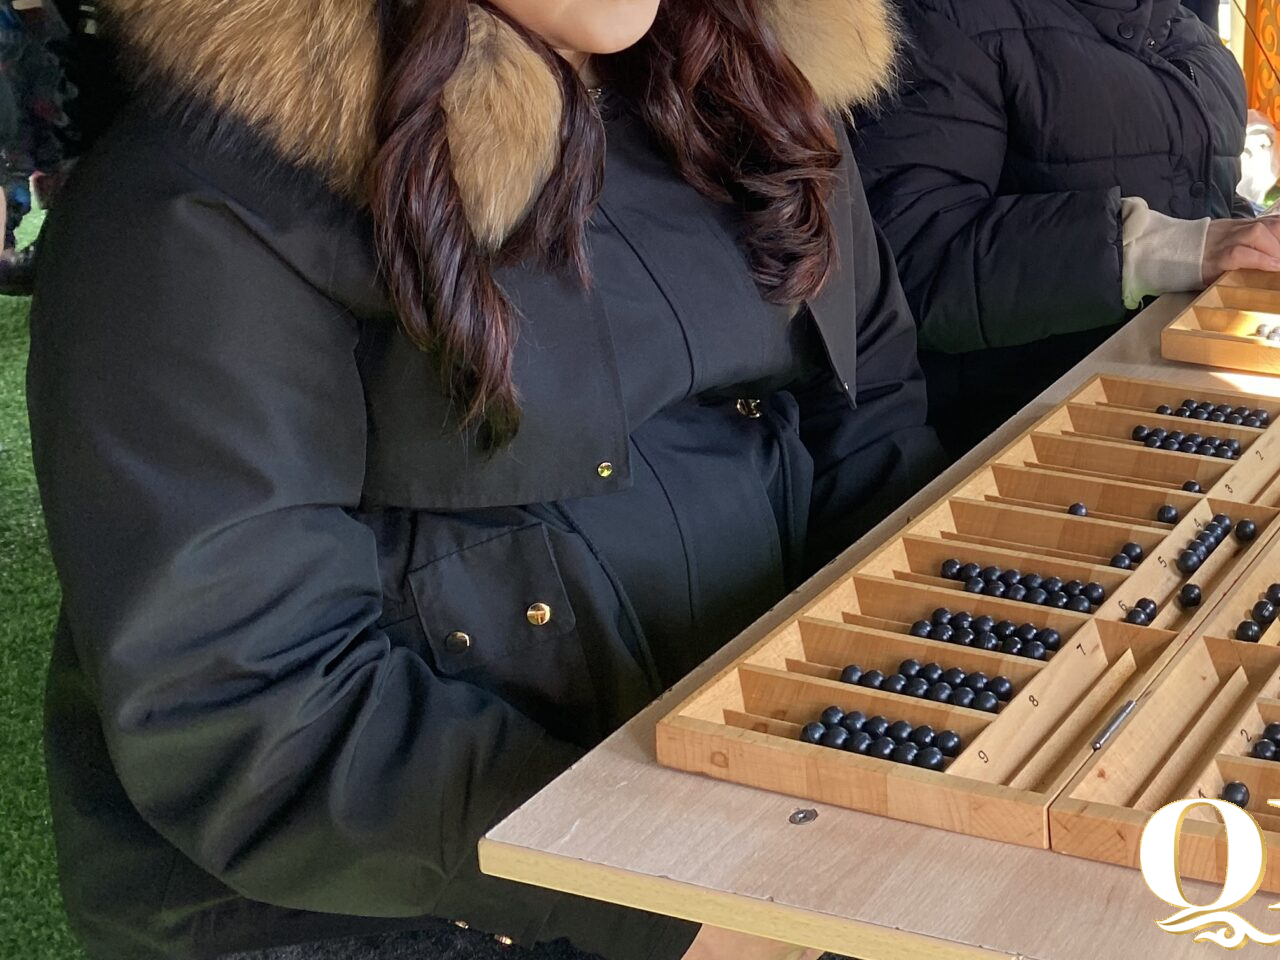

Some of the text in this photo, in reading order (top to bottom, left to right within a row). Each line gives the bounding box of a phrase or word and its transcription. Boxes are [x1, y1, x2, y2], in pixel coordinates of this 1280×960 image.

[1255, 450, 1264, 461] 2
[1225, 483, 1233, 494] 3
[1193, 517, 1201, 528] 4
[1158, 556, 1168, 568] 5
[1118, 600, 1128, 611] 6
[1076, 643, 1086, 656] 7
[1029, 695, 1039, 707] 8
[1240, 729, 1252, 743] 2
[978, 750, 989, 763] 9
